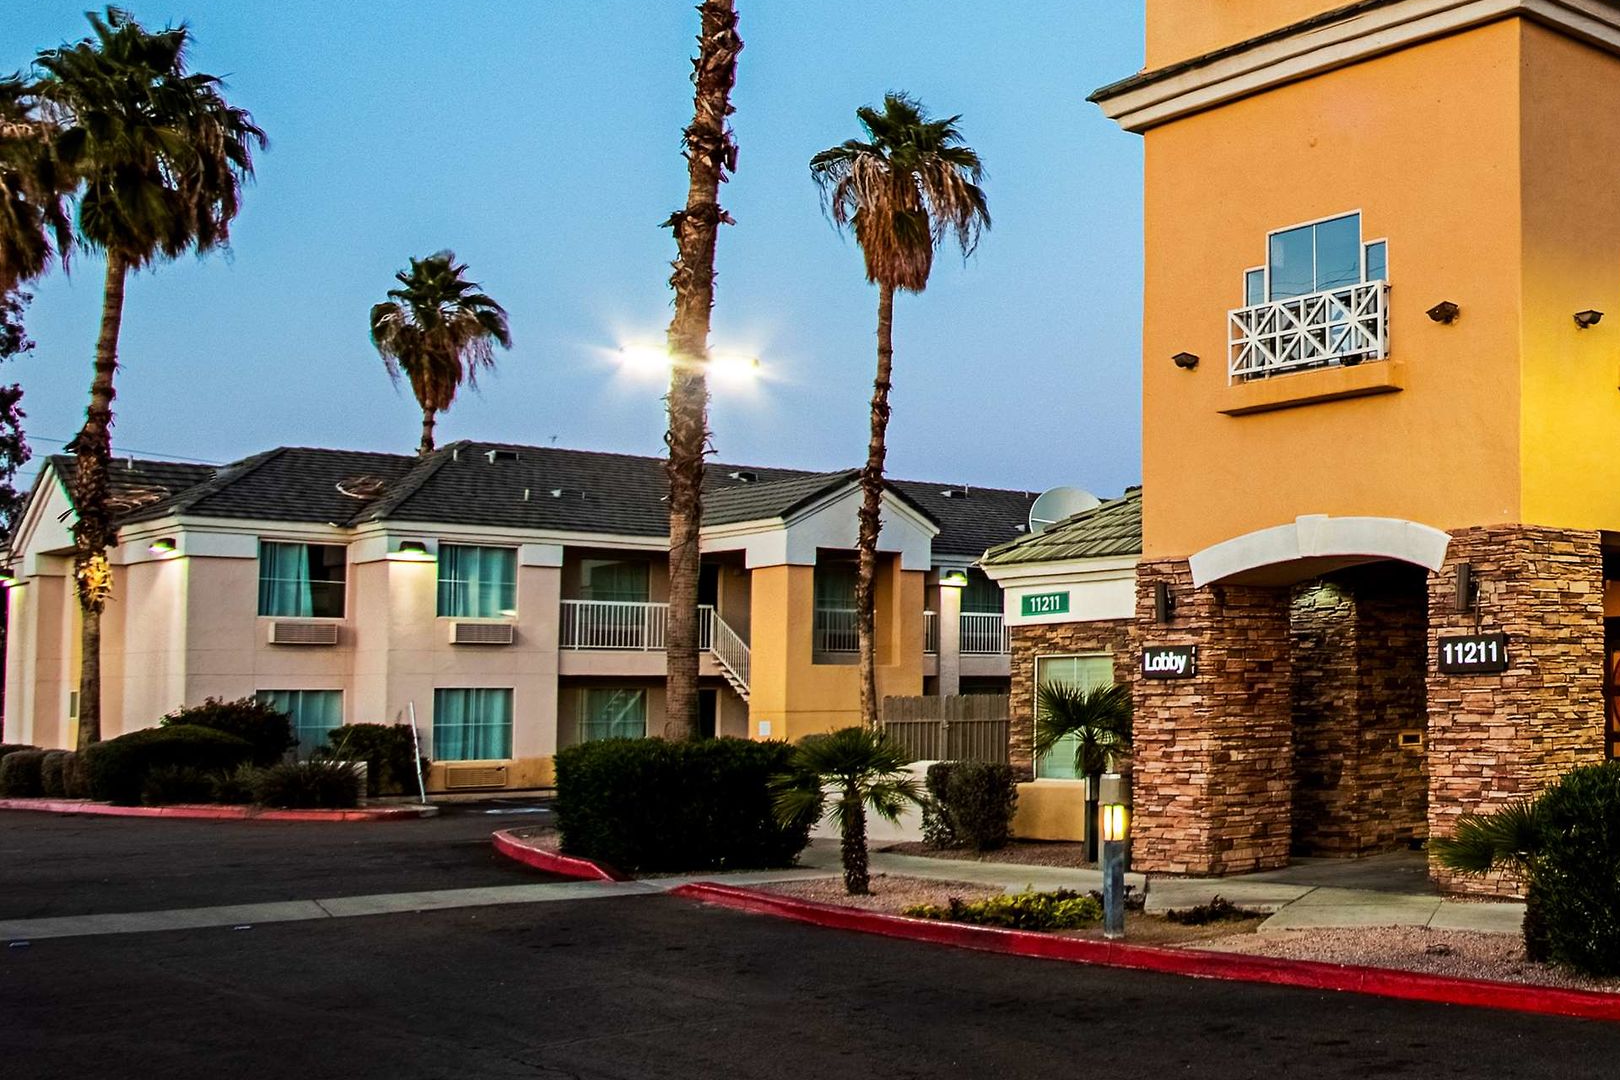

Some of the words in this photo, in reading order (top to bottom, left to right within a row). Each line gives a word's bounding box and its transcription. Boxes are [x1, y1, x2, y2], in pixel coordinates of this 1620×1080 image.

[1030, 595, 1060, 612] 11211
[1145, 651, 1187, 674] Lobby
[1443, 641, 1497, 664] 11211
